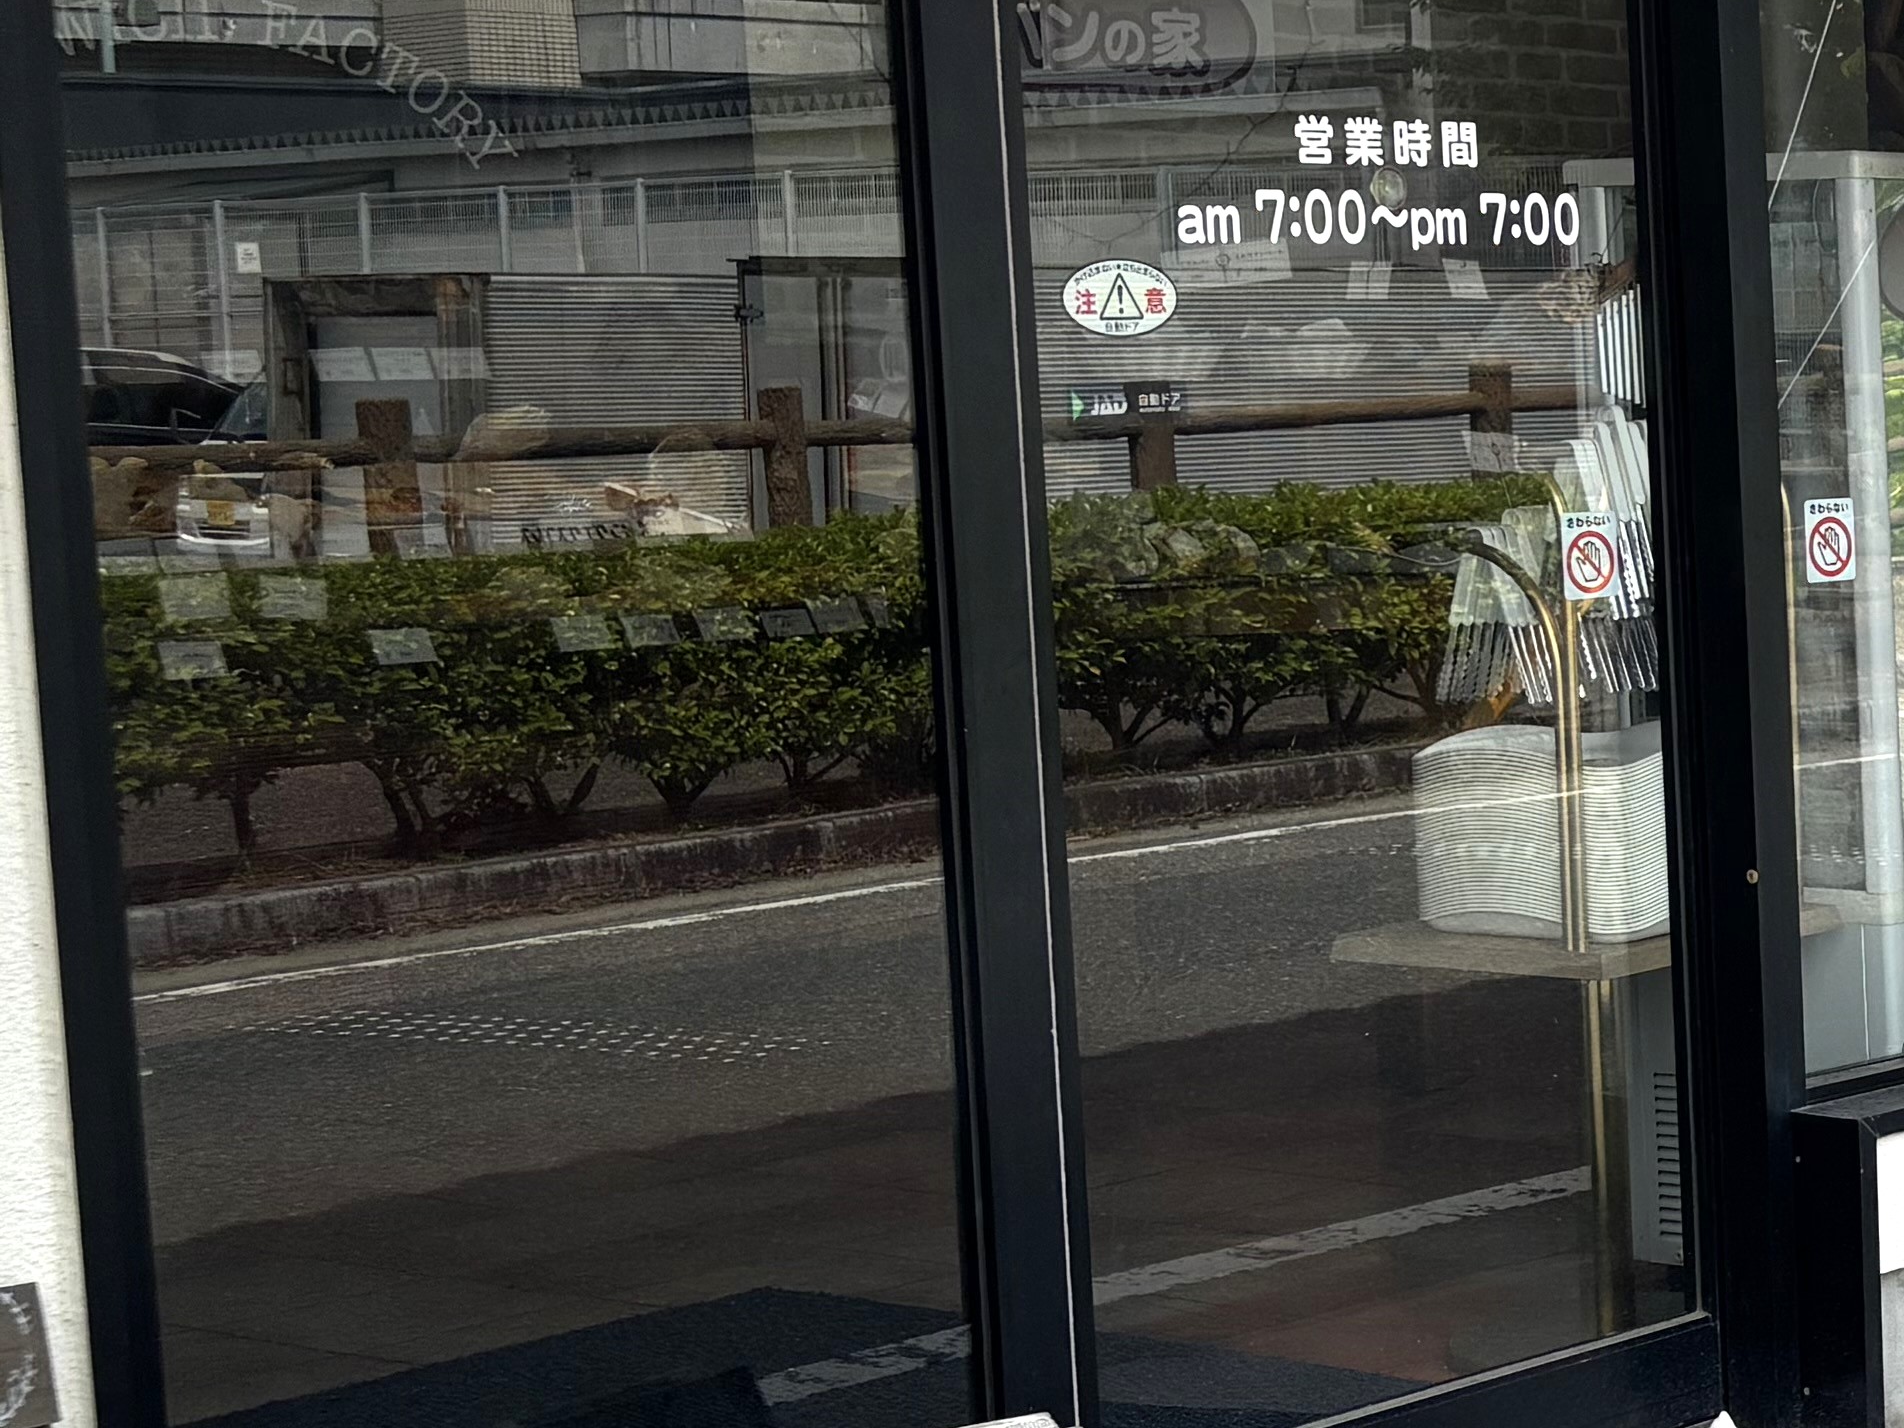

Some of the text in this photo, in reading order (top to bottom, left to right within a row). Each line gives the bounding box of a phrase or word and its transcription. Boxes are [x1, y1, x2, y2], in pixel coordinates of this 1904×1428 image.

[1294, 115, 1479, 169] 営業時間
[1176, 203, 1242, 246] am
[1479, 192, 1580, 247] 7:00
